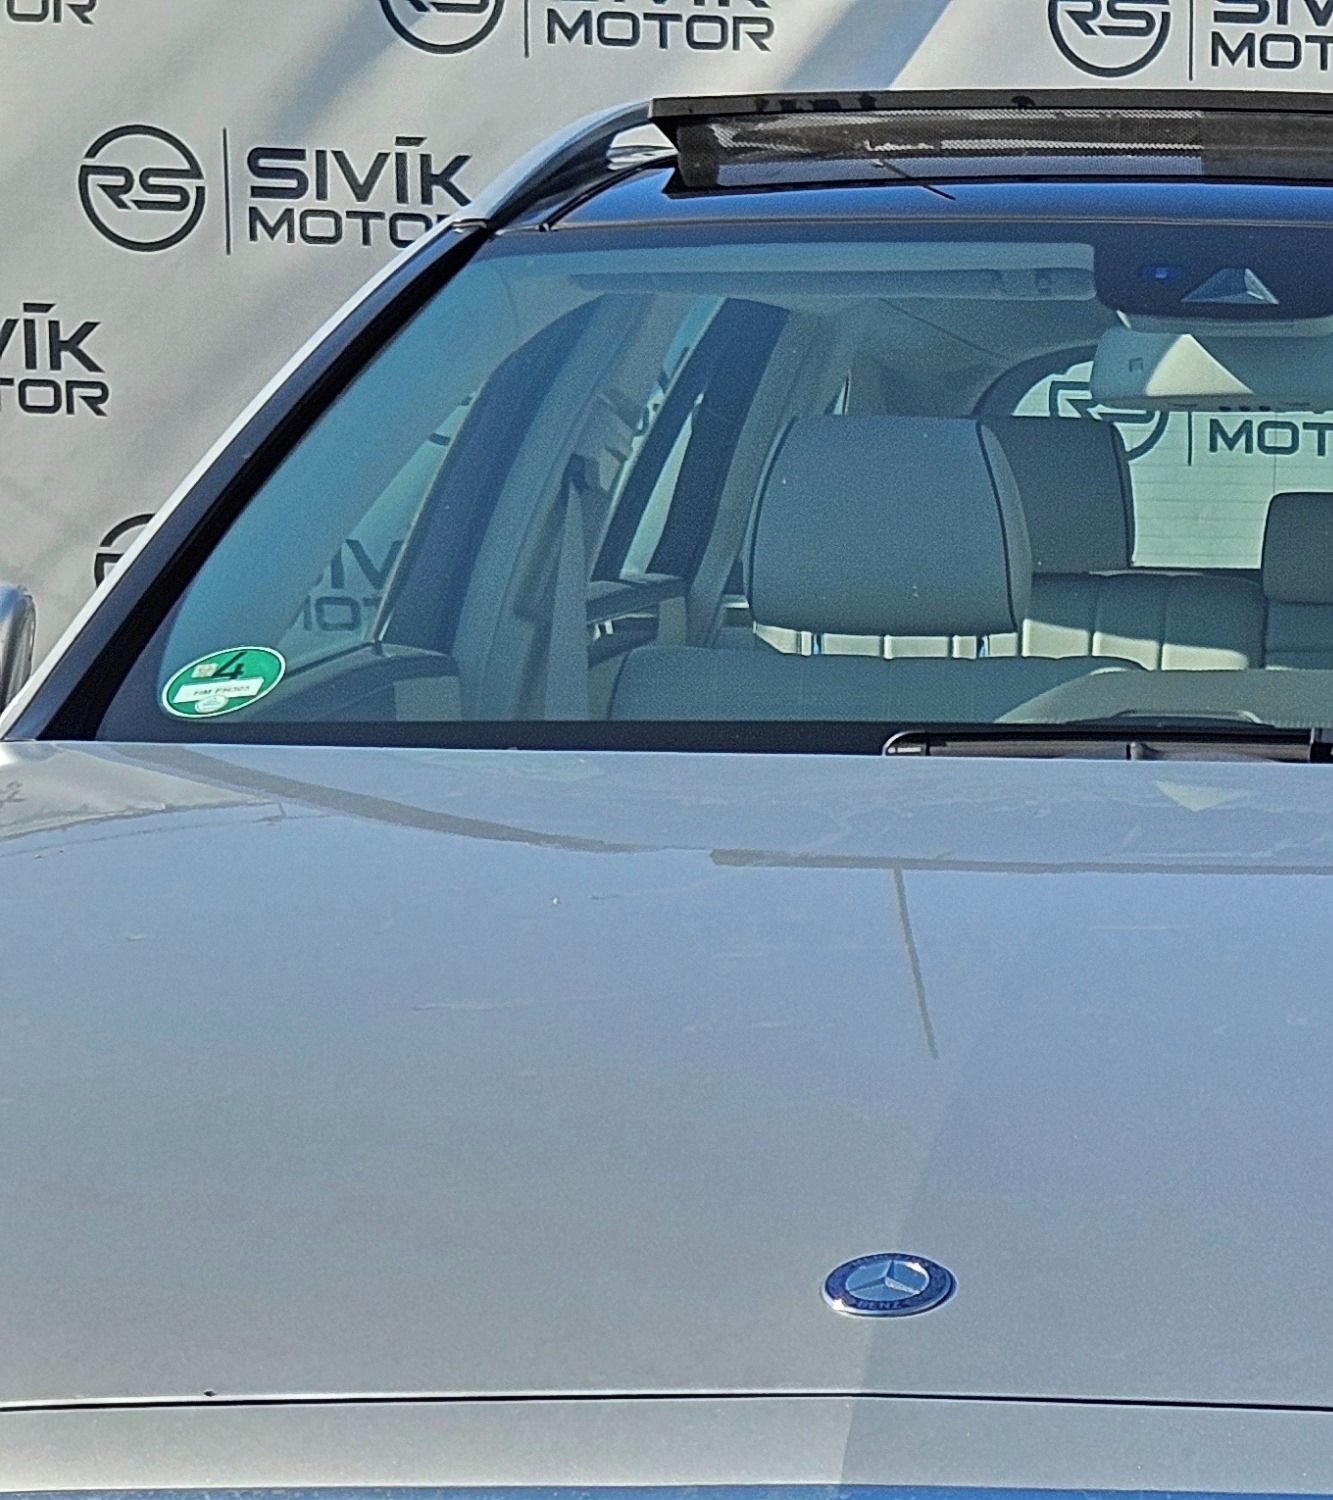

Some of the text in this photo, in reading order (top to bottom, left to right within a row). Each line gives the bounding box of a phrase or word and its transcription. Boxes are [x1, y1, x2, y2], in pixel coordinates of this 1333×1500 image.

[547, 8, 774, 51] MOTOR
[248, 206, 451, 248] MOTO
[211, 651, 248, 680] 4
